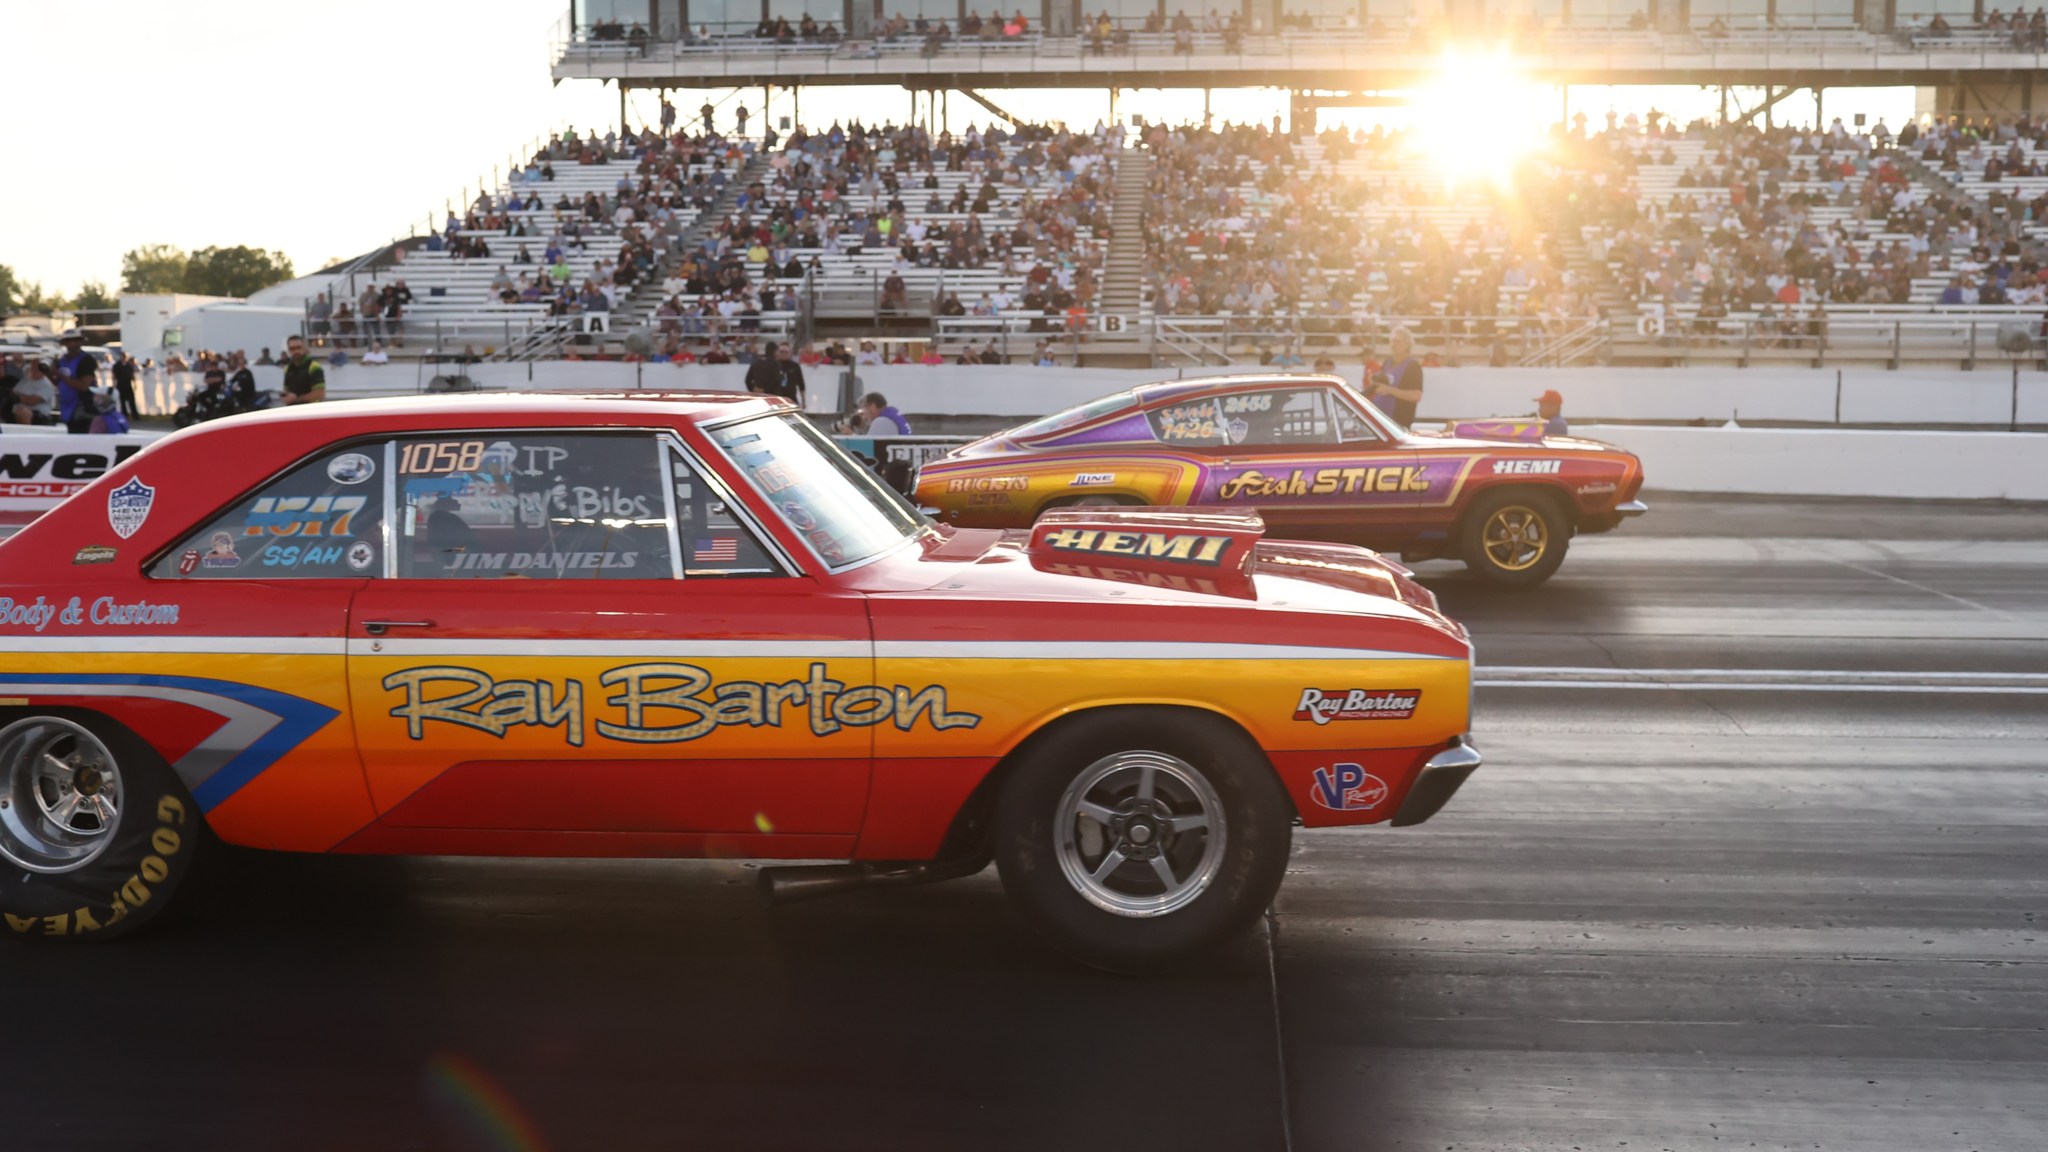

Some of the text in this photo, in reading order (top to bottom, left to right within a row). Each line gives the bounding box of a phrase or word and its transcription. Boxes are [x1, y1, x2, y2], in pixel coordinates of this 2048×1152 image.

[590, 317, 603, 331] A
[1106, 316, 1120, 331] B
[1644, 318, 1659, 334] C
[399, 441, 484, 474] 1058
[1493, 460, 1561, 474] HEMI
[1220, 466, 1430, 499] Fish STICK
[572, 486, 651, 519] Bibs
[262, 541, 343, 570] SS/AH
[444, 552, 639, 569] JIM DANIELS
[1045, 527, 1232, 567] HEMI
[0, 596, 179, 632] Body & Custom
[383, 662, 982, 748] Ray Barton
[1297, 689, 1416, 725] Ray Barton
[1313, 762, 1365, 809] VP
